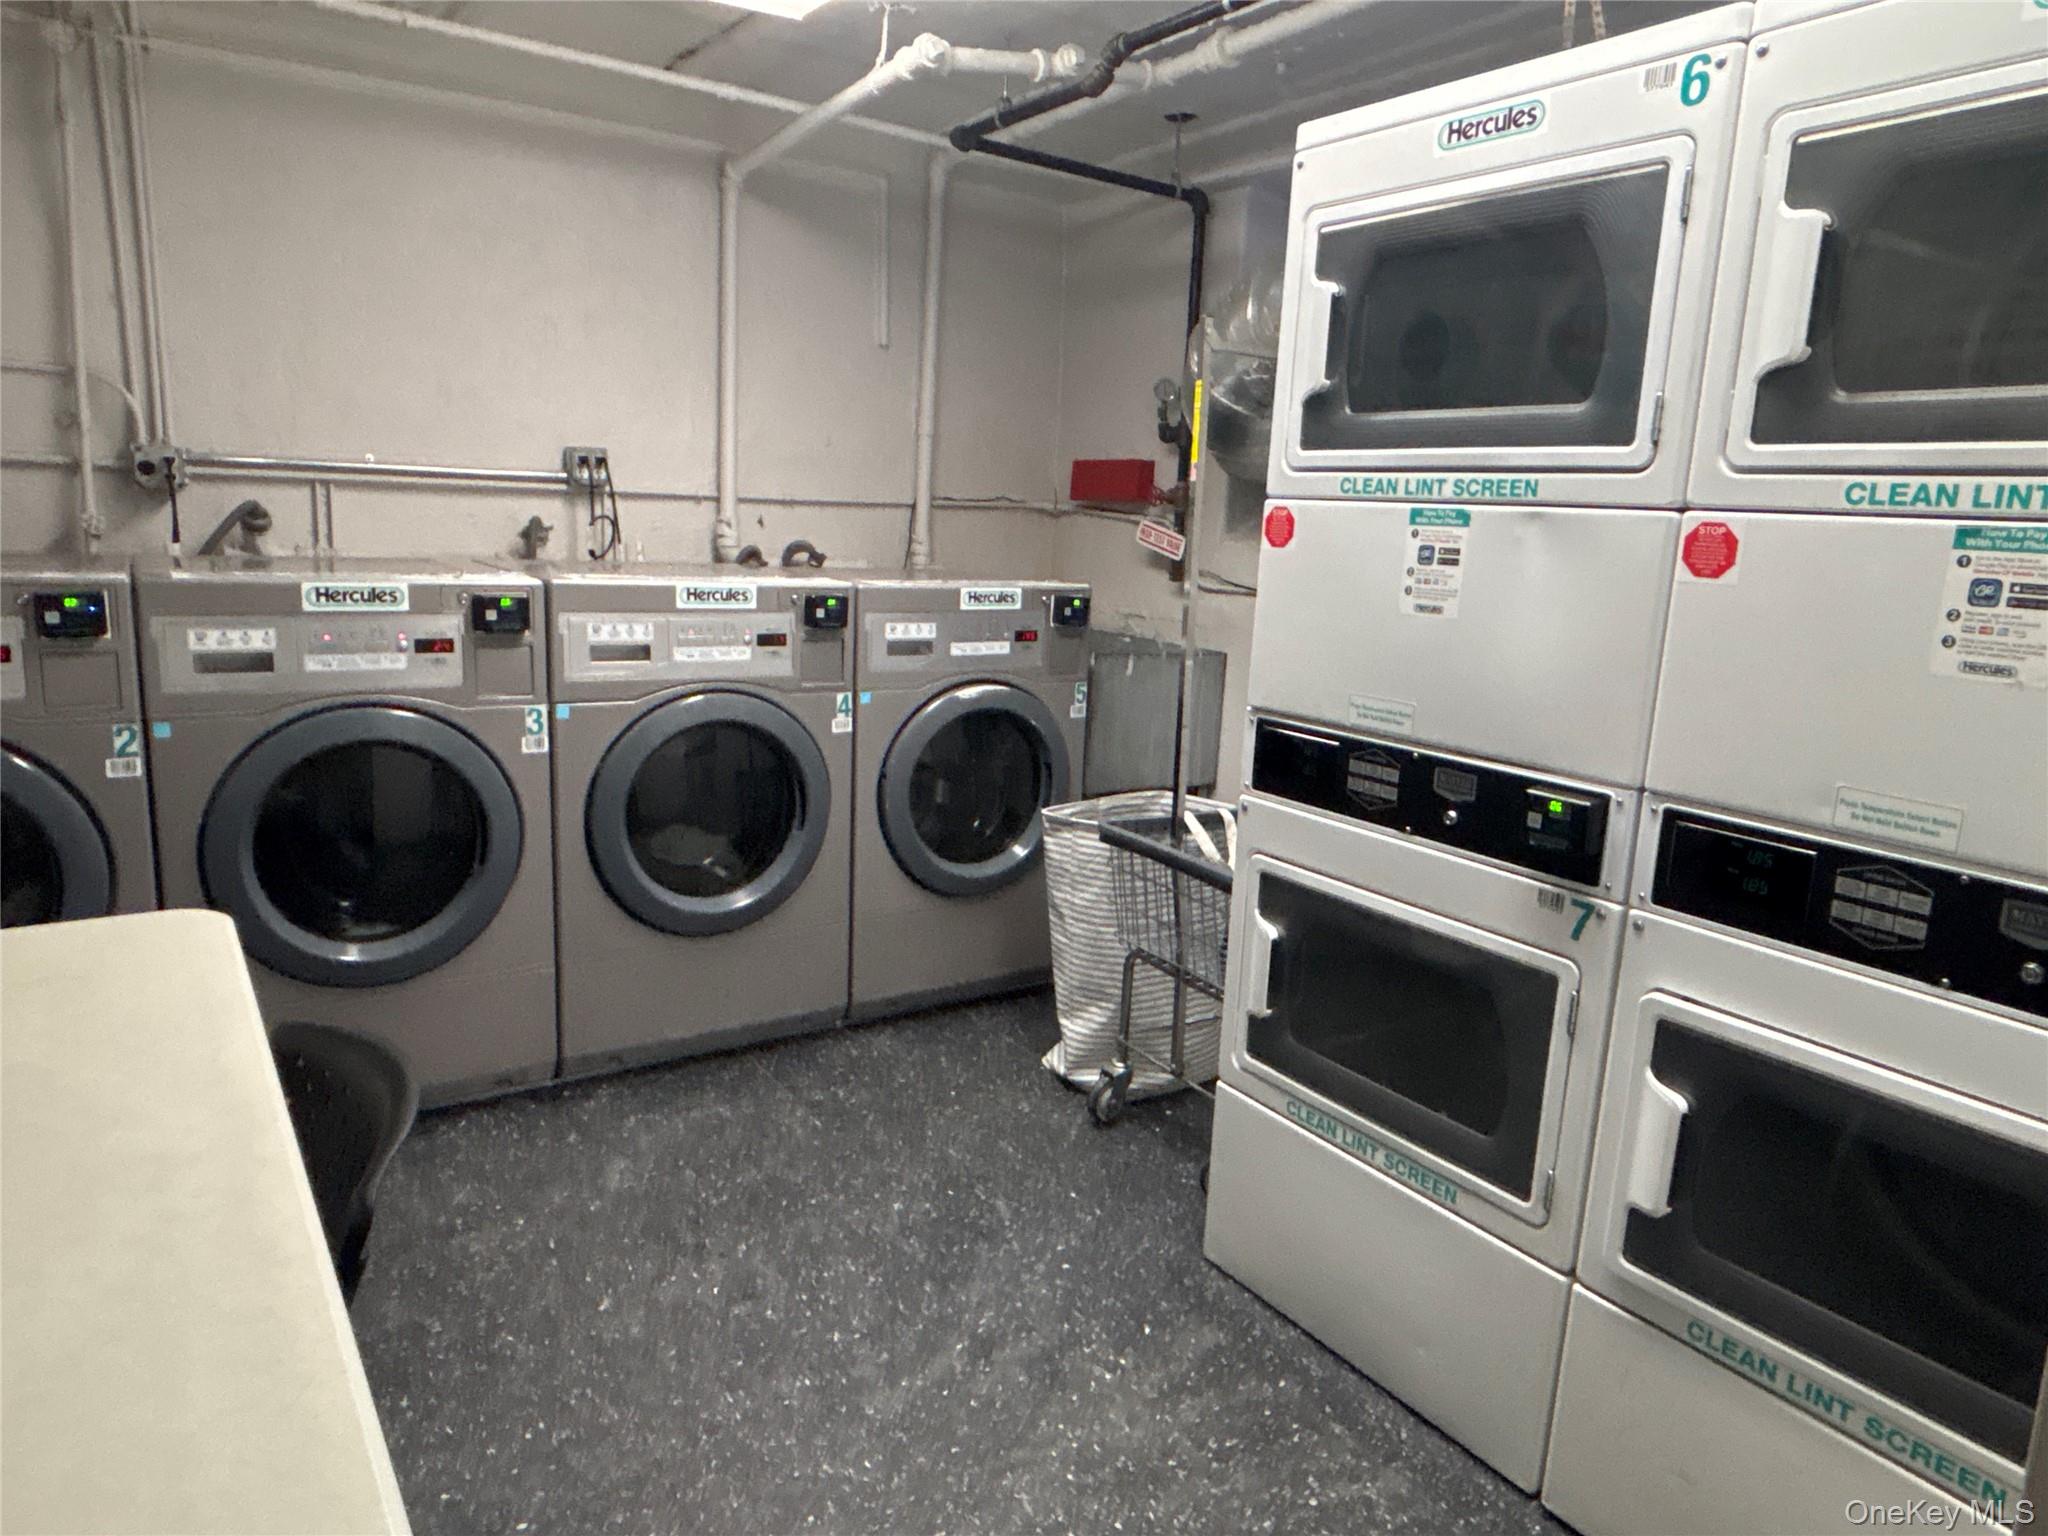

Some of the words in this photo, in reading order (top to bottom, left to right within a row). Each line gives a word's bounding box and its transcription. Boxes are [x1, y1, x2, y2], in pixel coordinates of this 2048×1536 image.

[1680, 53, 1711, 107] 6
[1446, 106, 1538, 144] Hercules
[1340, 477, 1398, 495] CLEAN
[1404, 478, 1446, 496] LINT
[1452, 479, 1539, 498] SCREEN
[1844, 482, 1960, 507] CLEAN
[1699, 525, 1727, 536] STOP
[315, 587, 398, 603] Hercules
[686, 587, 748, 602] Hercules
[968, 591, 1015, 603] Hercules
[1962, 660, 2013, 677] Hercules
[838, 694, 851, 717] 4
[1076, 683, 1087, 704] 5
[527, 708, 544, 735] 3
[114, 725, 139, 757] 2
[1570, 897, 1595, 942] 7
[1286, 1100, 1338, 1139] CLEAN
[1342, 1129, 1379, 1161] LINT
[1383, 1151, 1458, 1205] SCREEN
[1686, 1319, 1777, 1383] CLEAN
[1786, 1373, 1855, 1422] LINT
[1863, 1415, 2008, 1507] SCREEN
